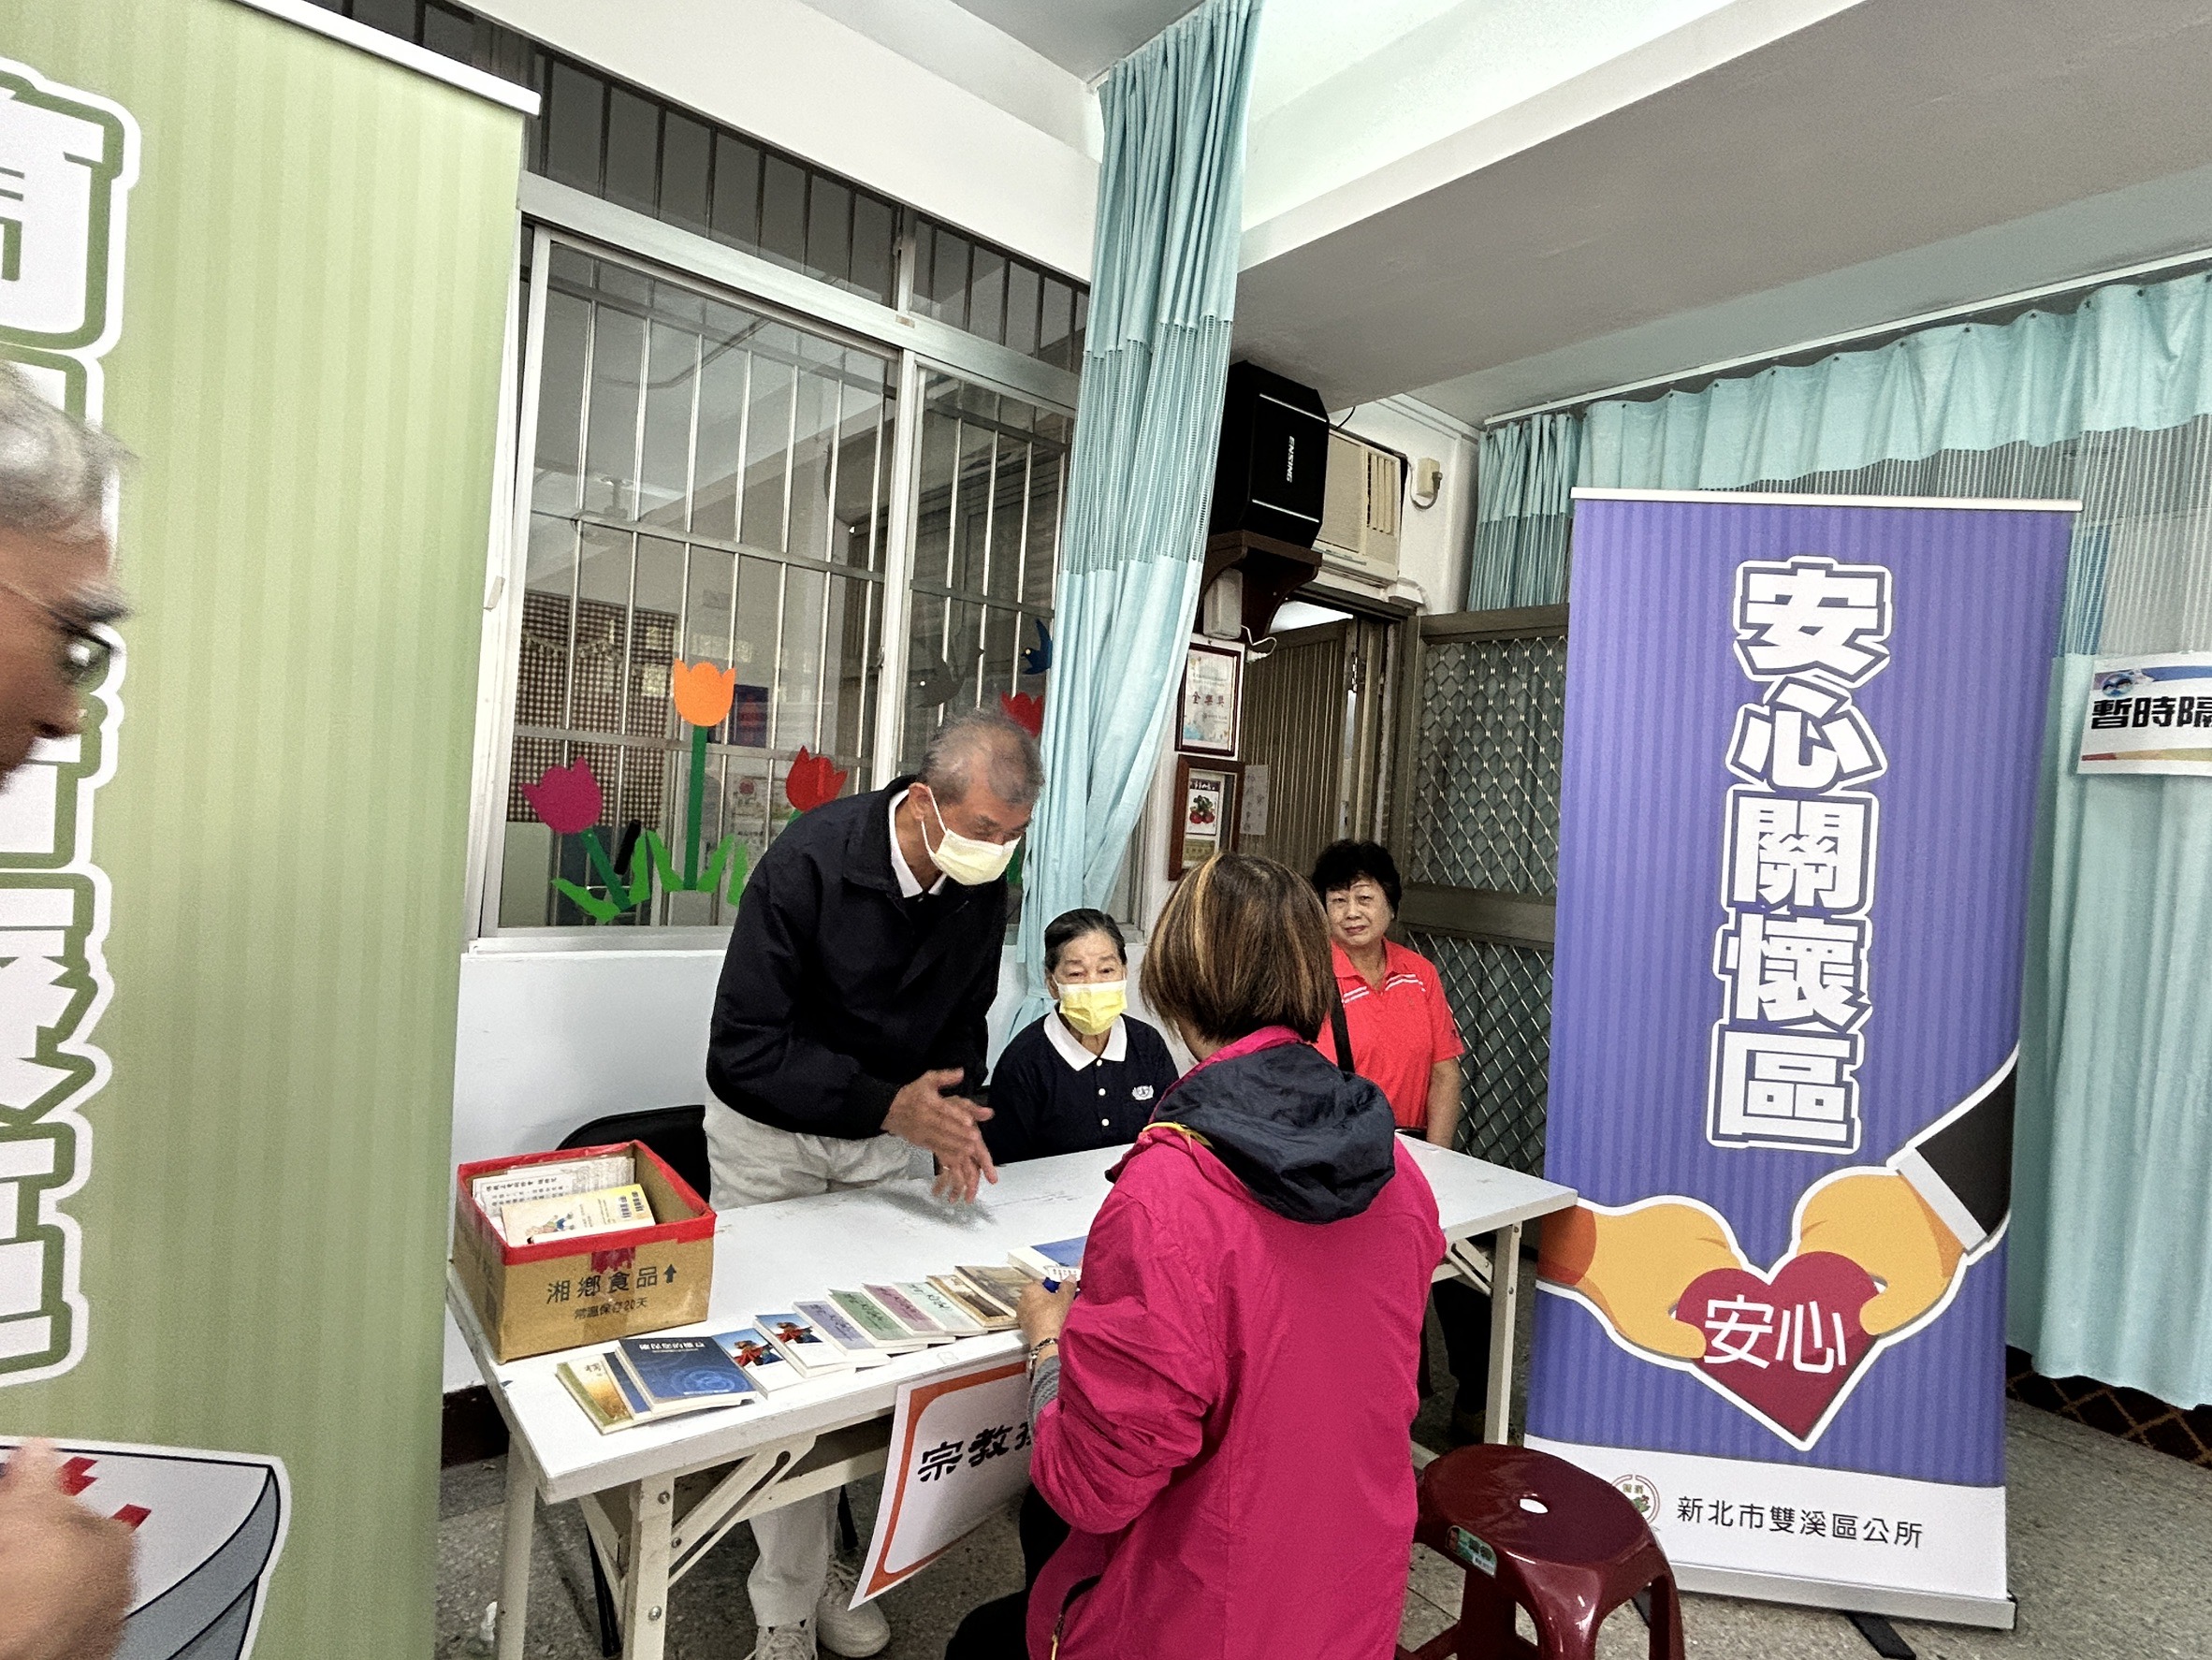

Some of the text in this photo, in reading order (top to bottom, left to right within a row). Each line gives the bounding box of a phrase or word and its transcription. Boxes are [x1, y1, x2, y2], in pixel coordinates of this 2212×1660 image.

[1287, 435, 1295, 483] ENSING
[2091, 696, 2212, 730] 暫時隔
[1707, 556, 1892, 1153] 安心關懷區
[546, 1266, 658, 1304] 湘鄉食品
[1703, 1293, 1847, 1374] 安心
[1677, 1495, 1924, 1549] 新北市雙溪區公所
